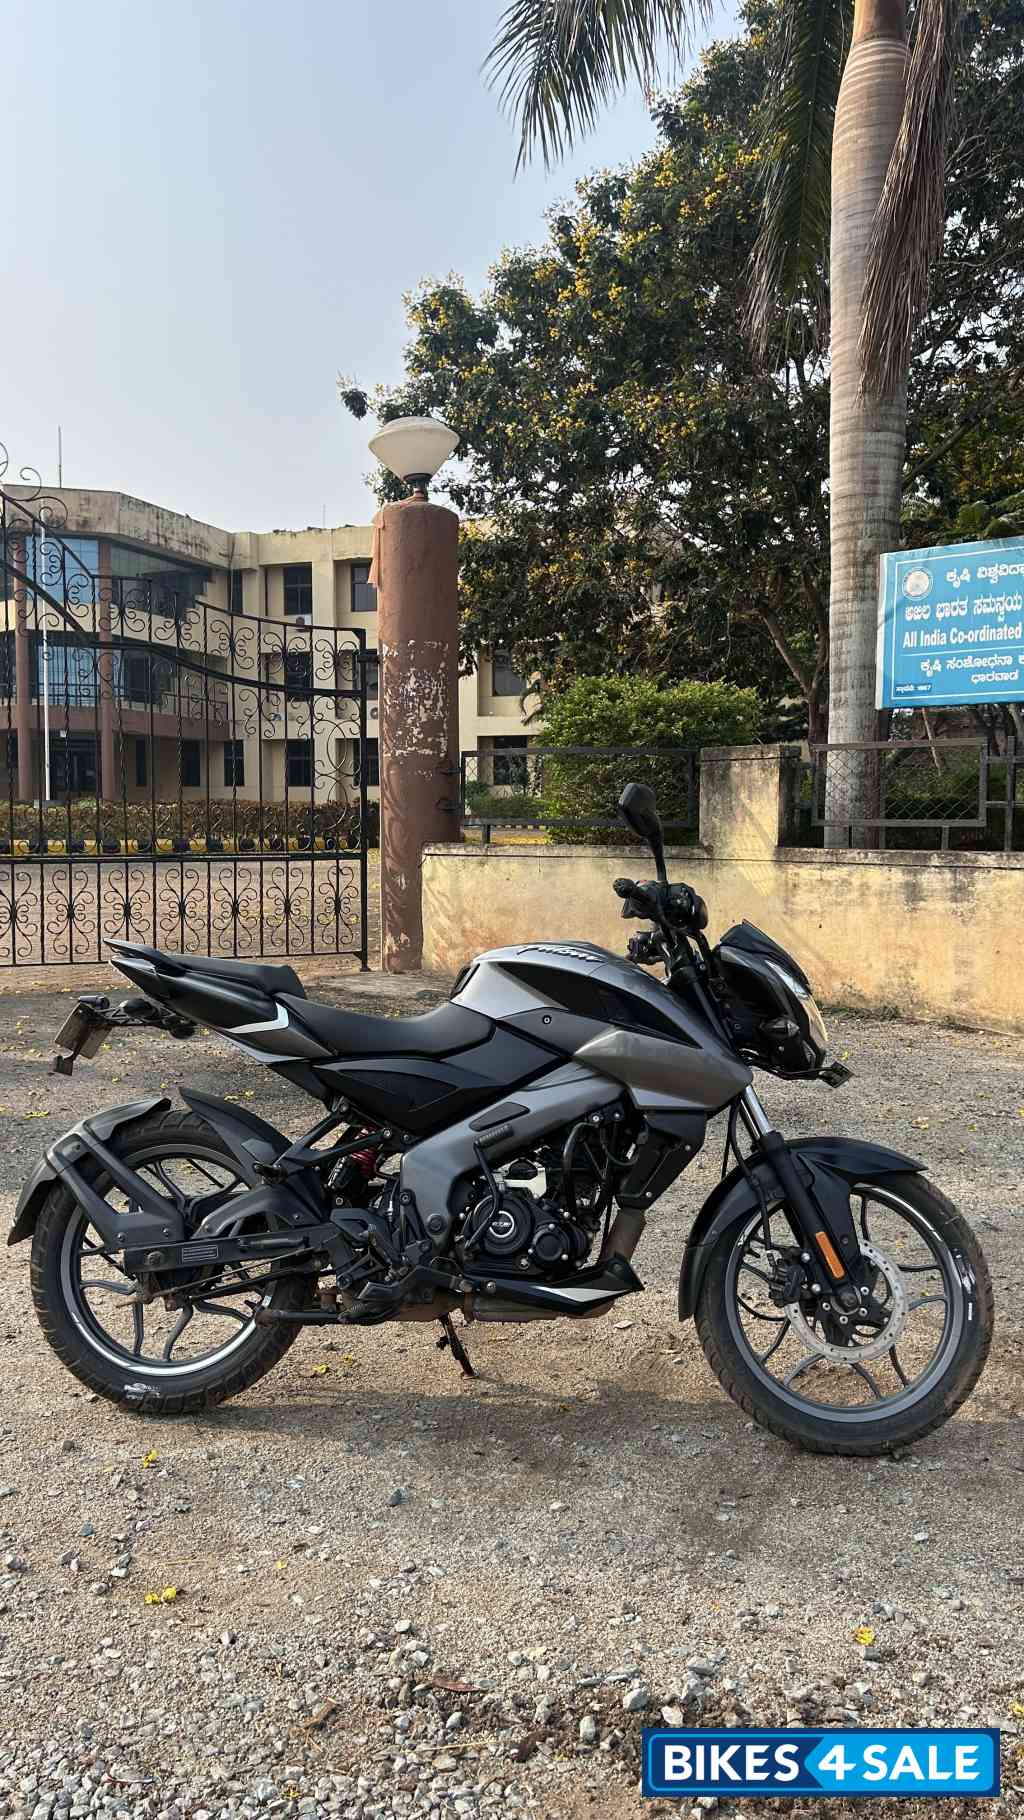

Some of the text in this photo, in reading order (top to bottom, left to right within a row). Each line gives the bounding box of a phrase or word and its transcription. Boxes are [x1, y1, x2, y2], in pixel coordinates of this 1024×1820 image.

[935, 597, 968, 621] ಭಾರತ
[903, 622, 1022, 648] All India Co-ordinated
[920, 658, 942, 677] ಕೃಷಿ
